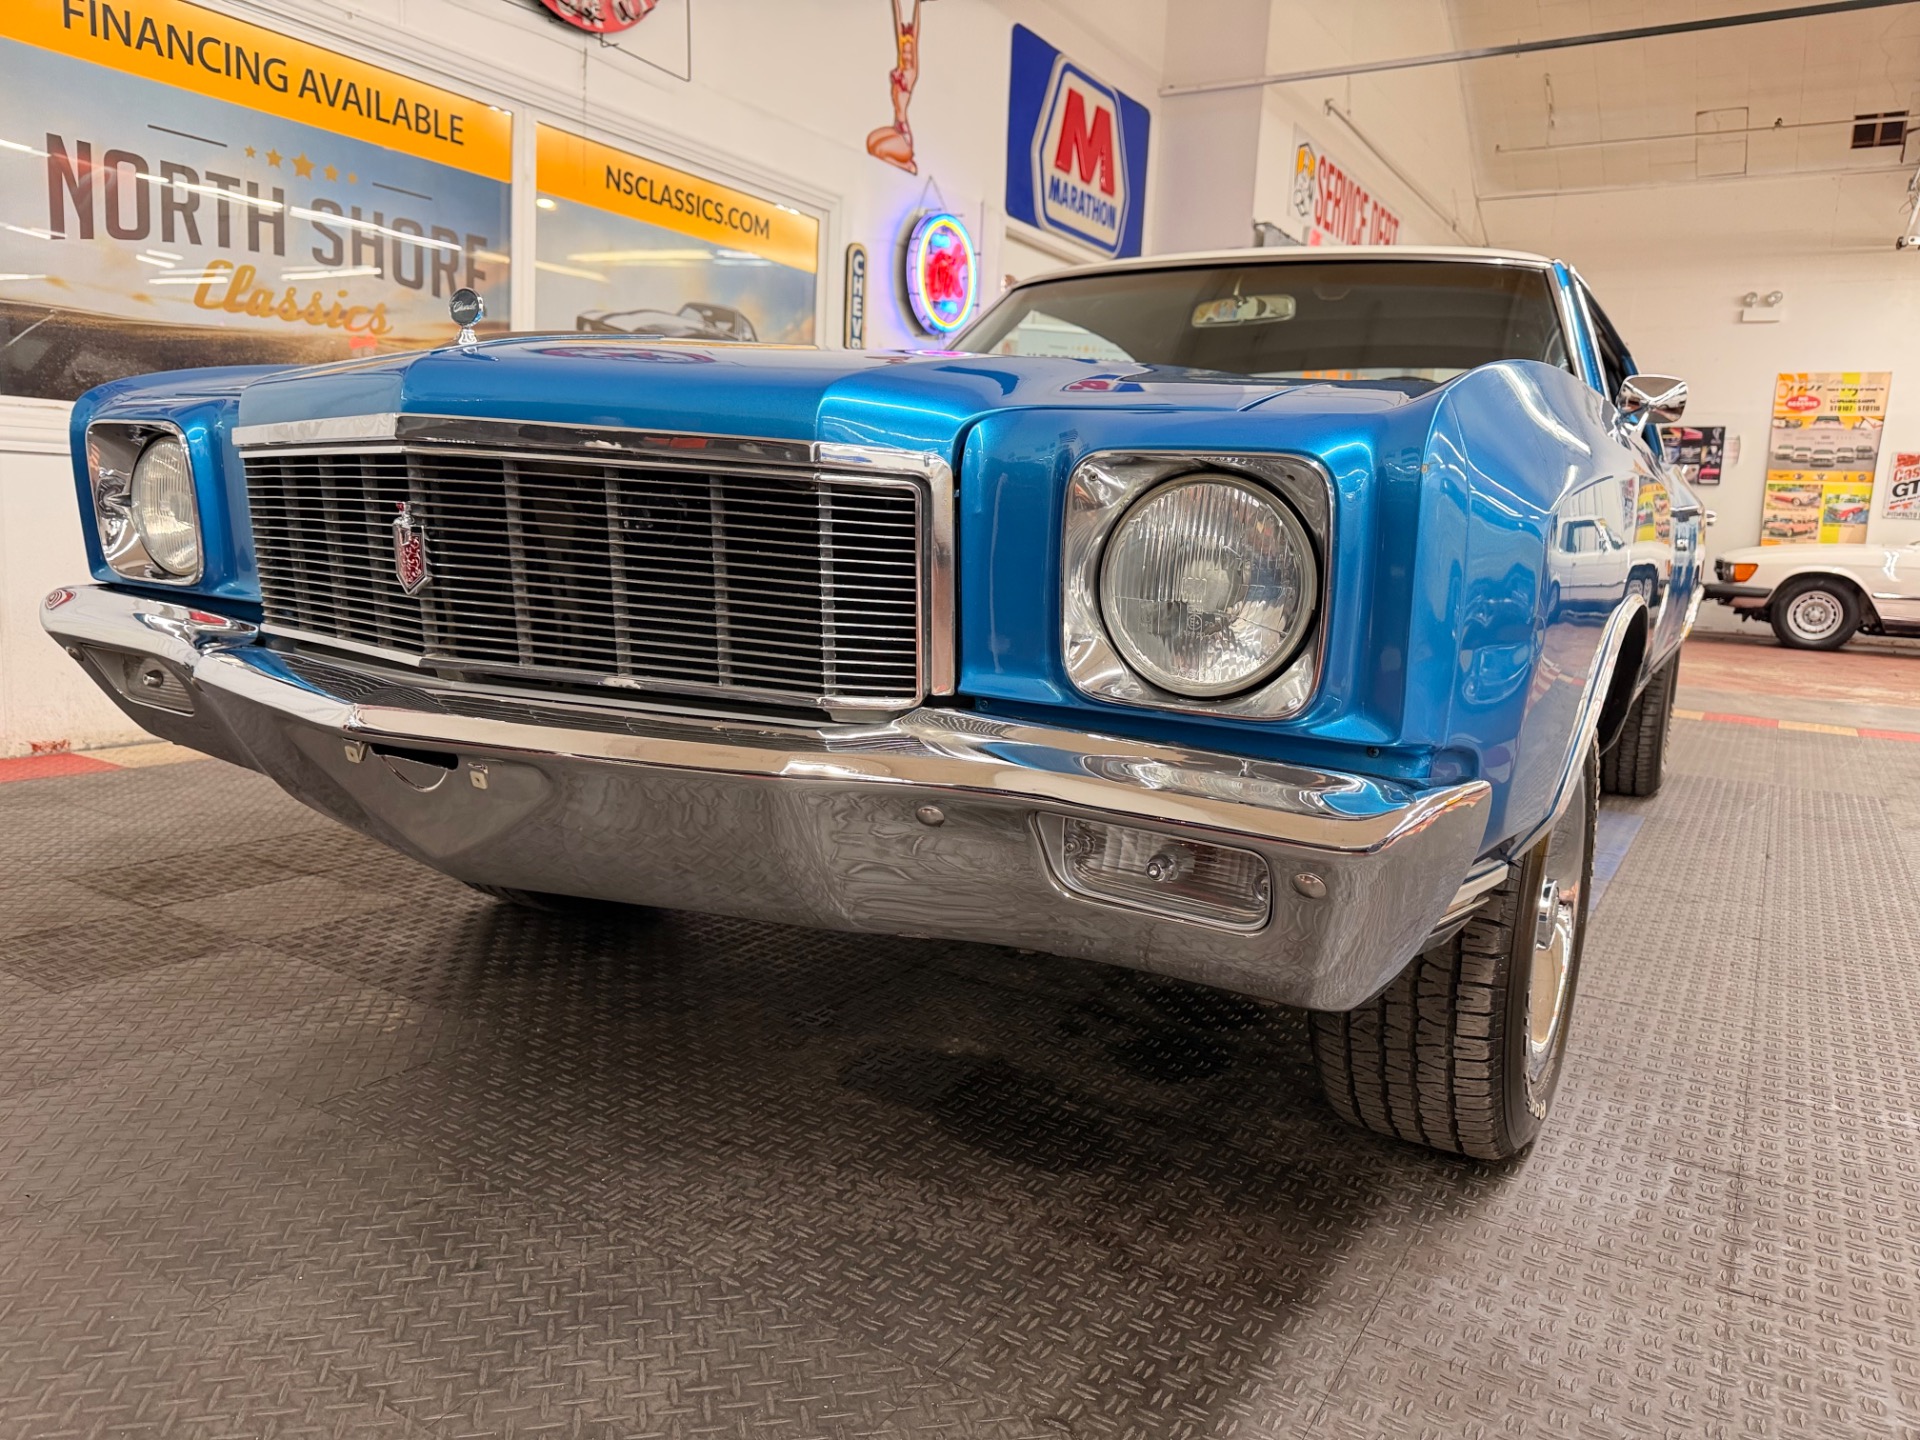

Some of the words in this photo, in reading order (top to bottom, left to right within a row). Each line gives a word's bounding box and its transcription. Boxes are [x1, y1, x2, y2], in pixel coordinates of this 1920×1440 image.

[62, 0, 288, 92] FINANCING
[298, 68, 464, 146] AVAILABLE
[1055, 87, 1115, 198] M
[46, 132, 285, 257] NORTH
[311, 198, 487, 298] SHORE
[606, 164, 770, 240] NSCLASSICS.COM
[1048, 175, 1118, 230] MARATHON
[1315, 154, 1369, 246] SERVICE
[1369, 200, 1399, 246] DEPT
[193, 259, 393, 335] Classics
